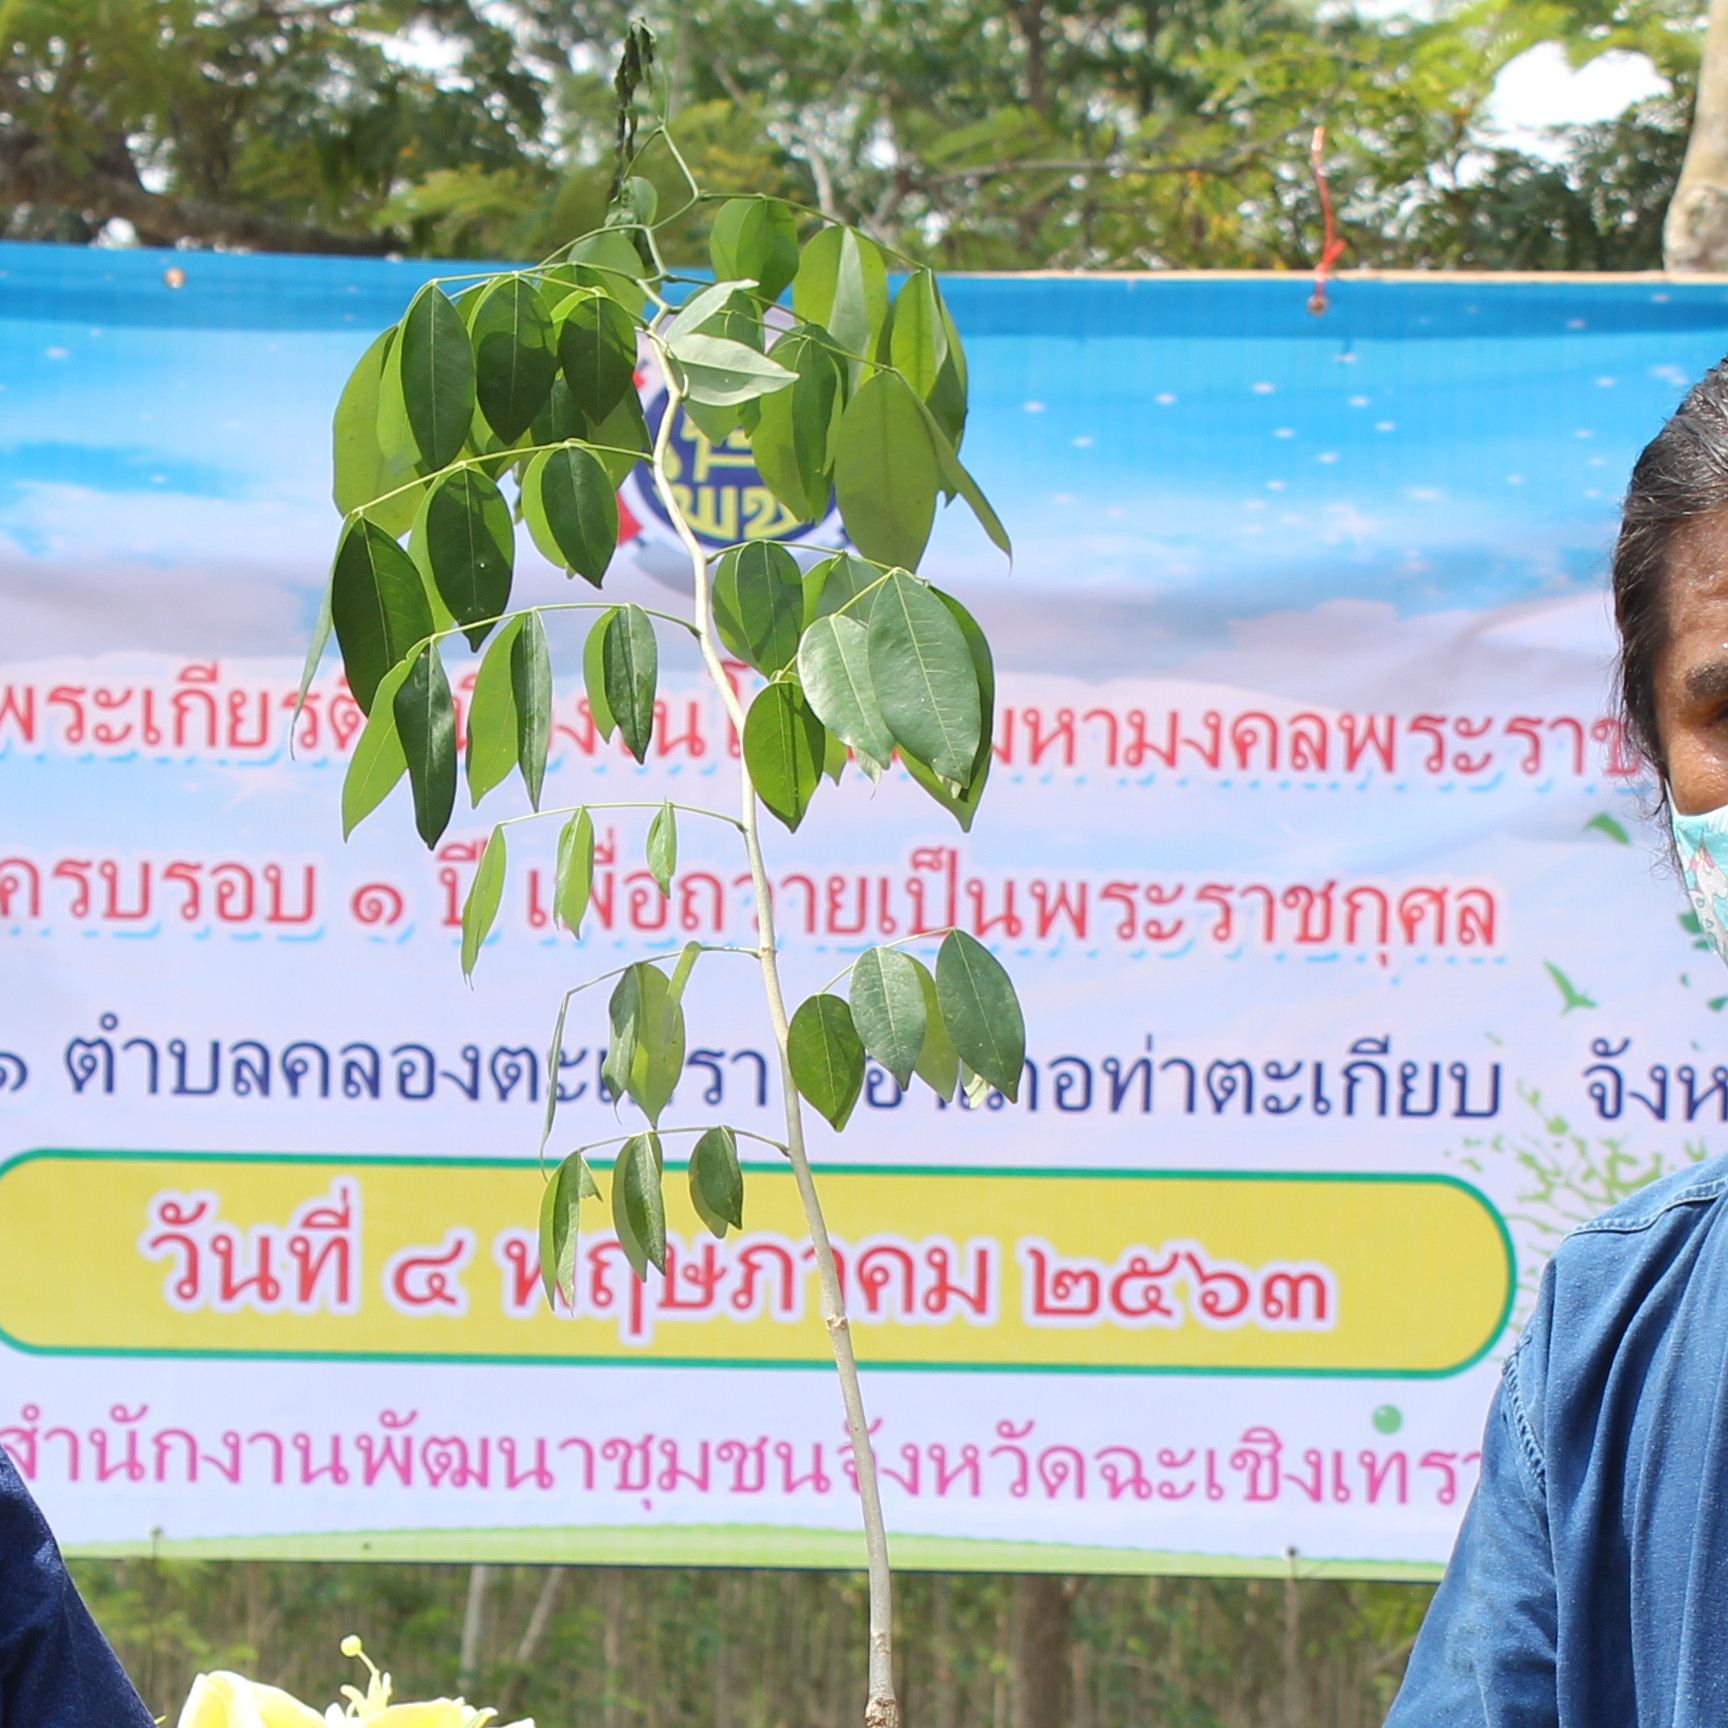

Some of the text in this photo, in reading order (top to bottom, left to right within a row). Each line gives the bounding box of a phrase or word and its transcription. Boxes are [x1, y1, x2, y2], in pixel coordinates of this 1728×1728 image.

[65, 1013, 767, 1106] ตำบลคลองตะเรา
[150, 1188, 350, 1308] วันที่
[392, 1238, 467, 1307] ๔
[1026, 1247, 1328, 1320] ๒๕๖๓
